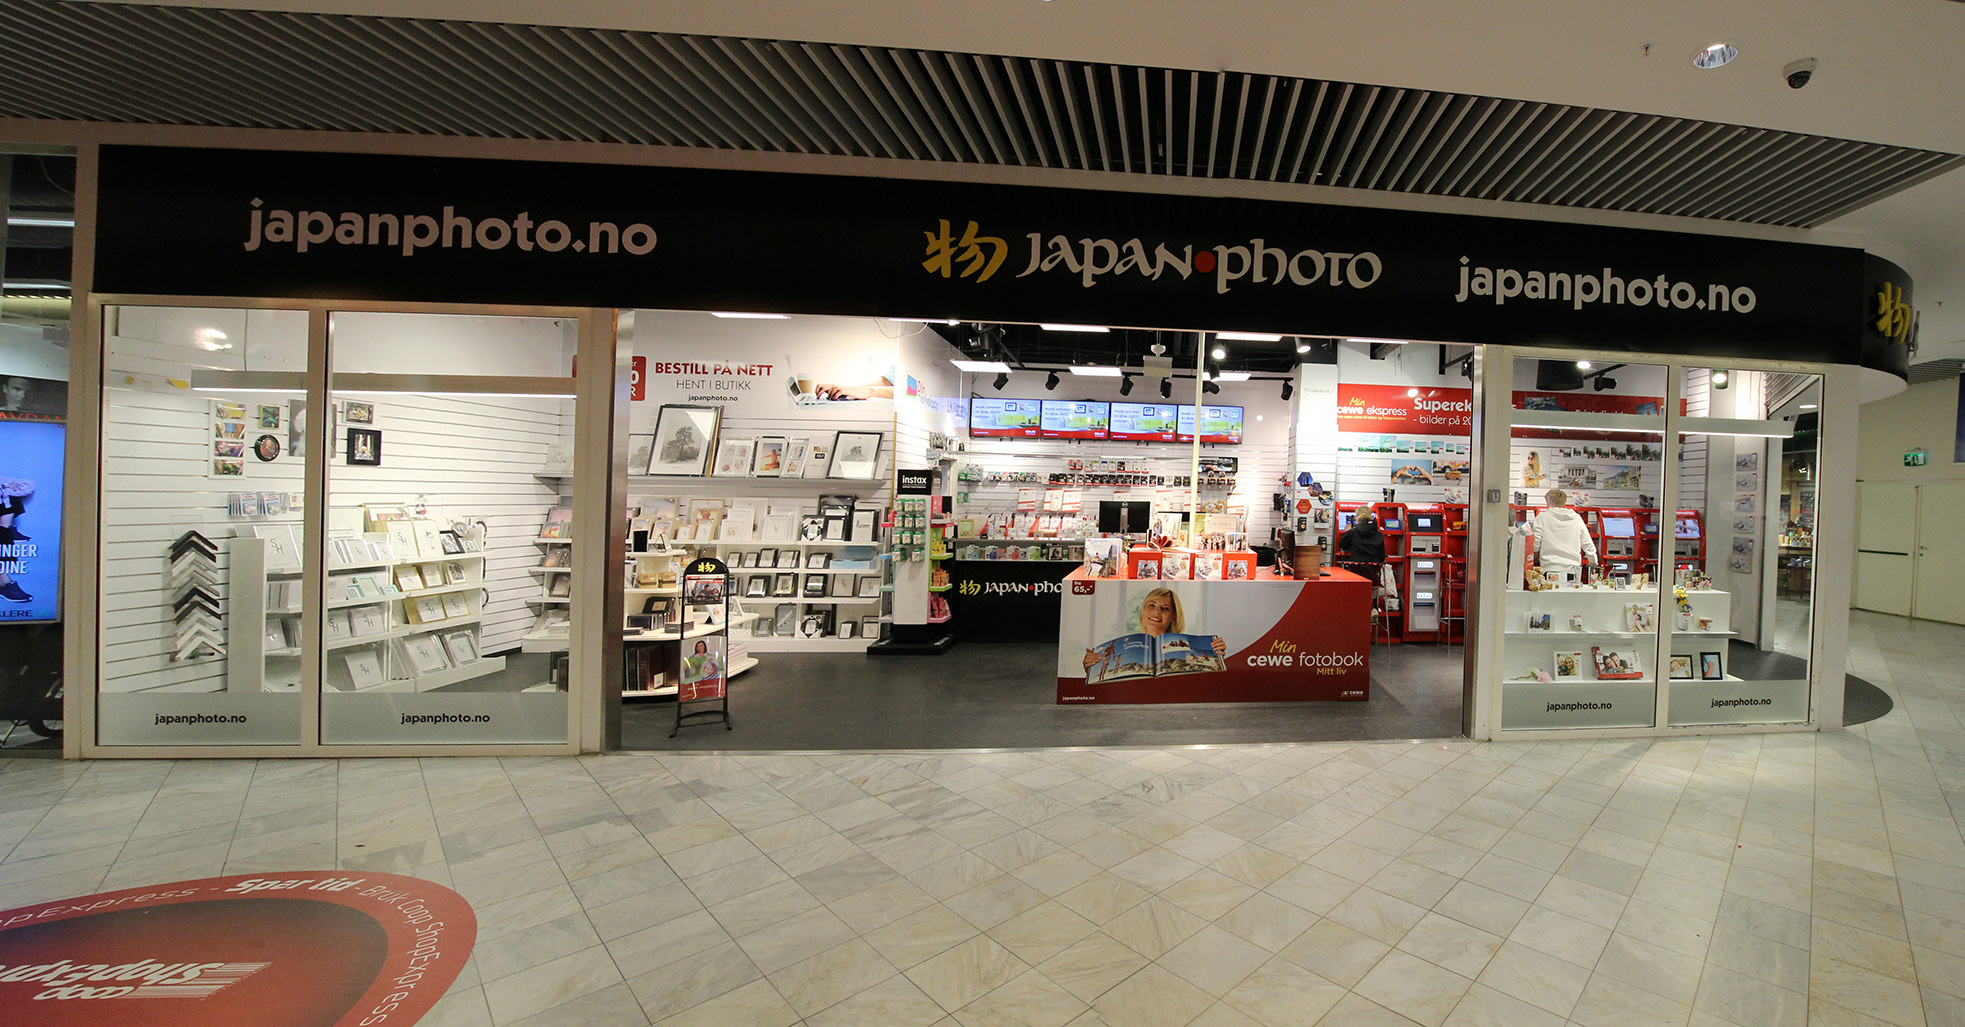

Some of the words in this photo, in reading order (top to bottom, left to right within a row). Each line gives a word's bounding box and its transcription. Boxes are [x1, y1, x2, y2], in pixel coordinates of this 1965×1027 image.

[244, 196, 657, 256] japanphoto.no
[1455, 255, 1756, 313] japanphoto.no
[655, 362, 708, 375] BESTILL
[713, 360, 732, 375] PÅ
[737, 364, 773, 376] NETT
[676, 379, 706, 389] HENT
[715, 380, 751, 390] BUTIKK
[688, 394, 738, 402] japanphoto.no
[1349, 397, 1365, 406] Min
[1366, 405, 1407, 416] ekspress
[1419, 414, 1446, 425] bilder
[1448, 415, 1460, 427] på
[902, 475, 928, 484] instax
[1270, 639, 1297, 653] Min
[1247, 655, 1293, 667] cewe
[1299, 652, 1363, 667] fotobok
[1336, 667, 1347, 675] liv
[1546, 701, 1612, 713] japanphoto.no
[1711, 697, 1771, 708] japanphoto.no
[154, 713, 247, 725] japanphoto.no
[401, 713, 490, 725] japanphoto.no
[225, 878, 315, 894] Spar
[359, 885, 410, 904] Bruk
[397, 898, 433, 925] Coop
